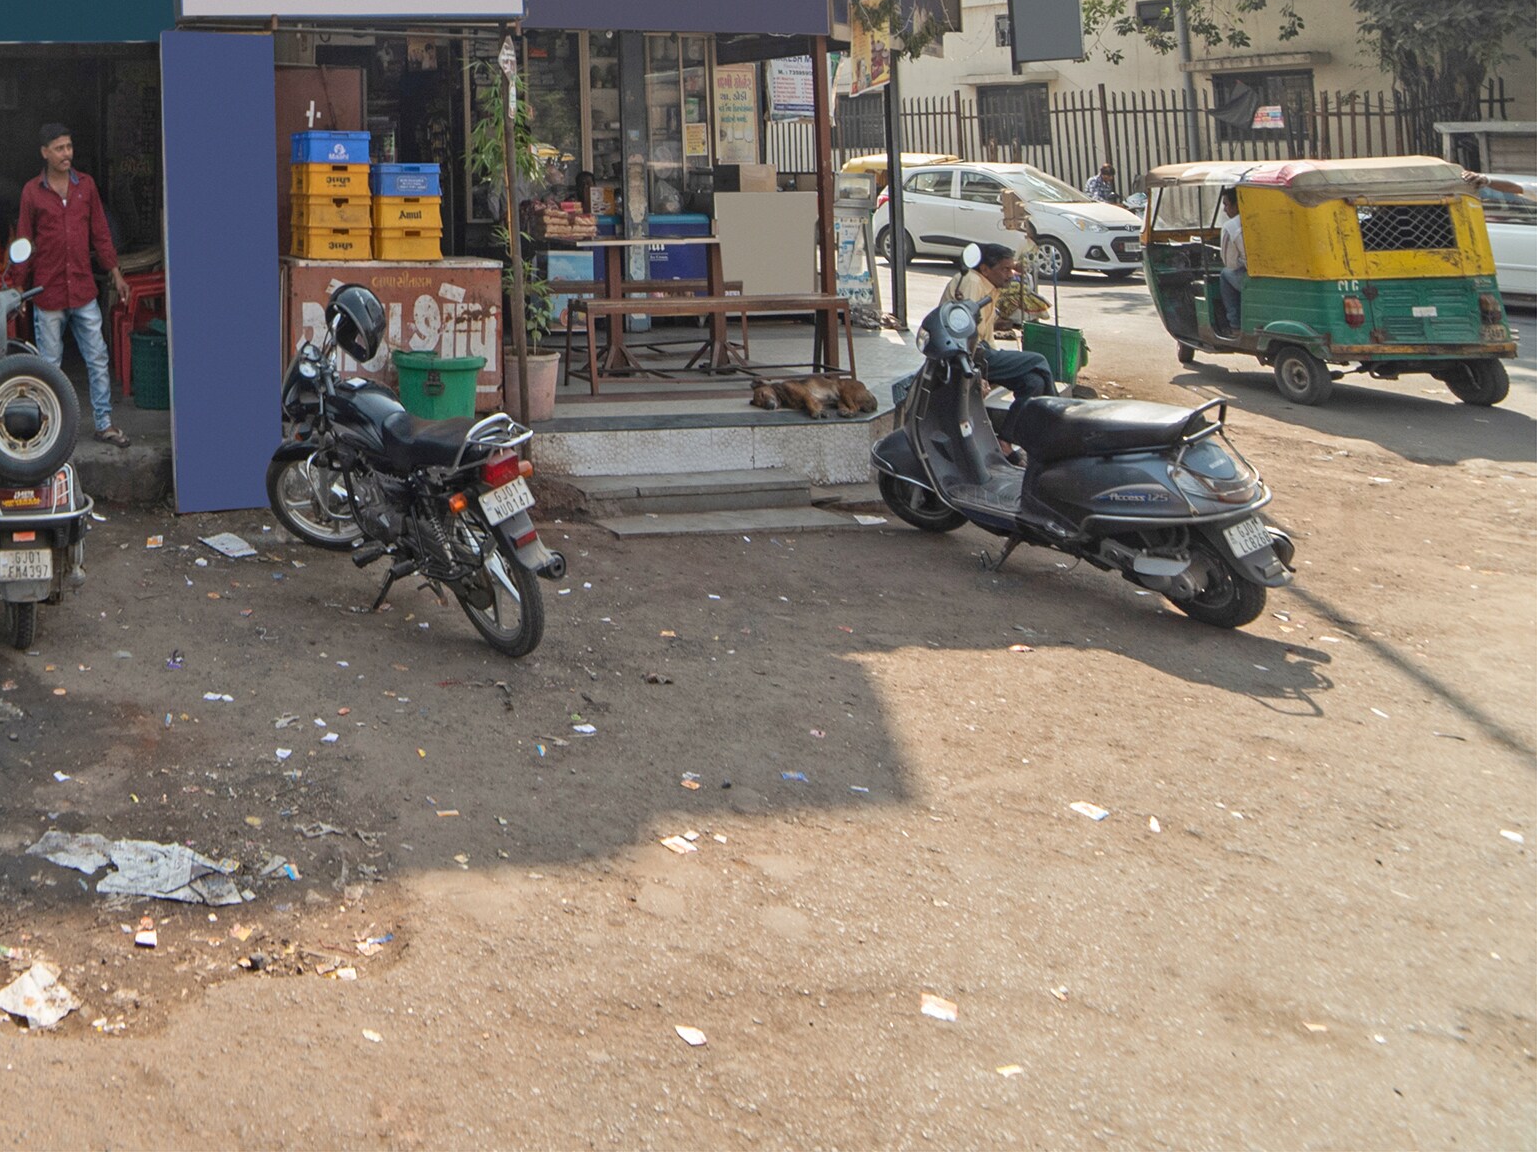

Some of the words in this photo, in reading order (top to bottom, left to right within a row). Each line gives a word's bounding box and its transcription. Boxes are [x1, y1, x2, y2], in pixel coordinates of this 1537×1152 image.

[398, 209, 422, 219] Amul
[494, 483, 519, 503] GJ01
[1109, 492, 1146, 502] Access
[1148, 493, 1169, 502] 125
[494, 491, 529, 519] NU0147
[1236, 519, 1259, 538] GJ01
[15, 550, 40, 564] GJ01
